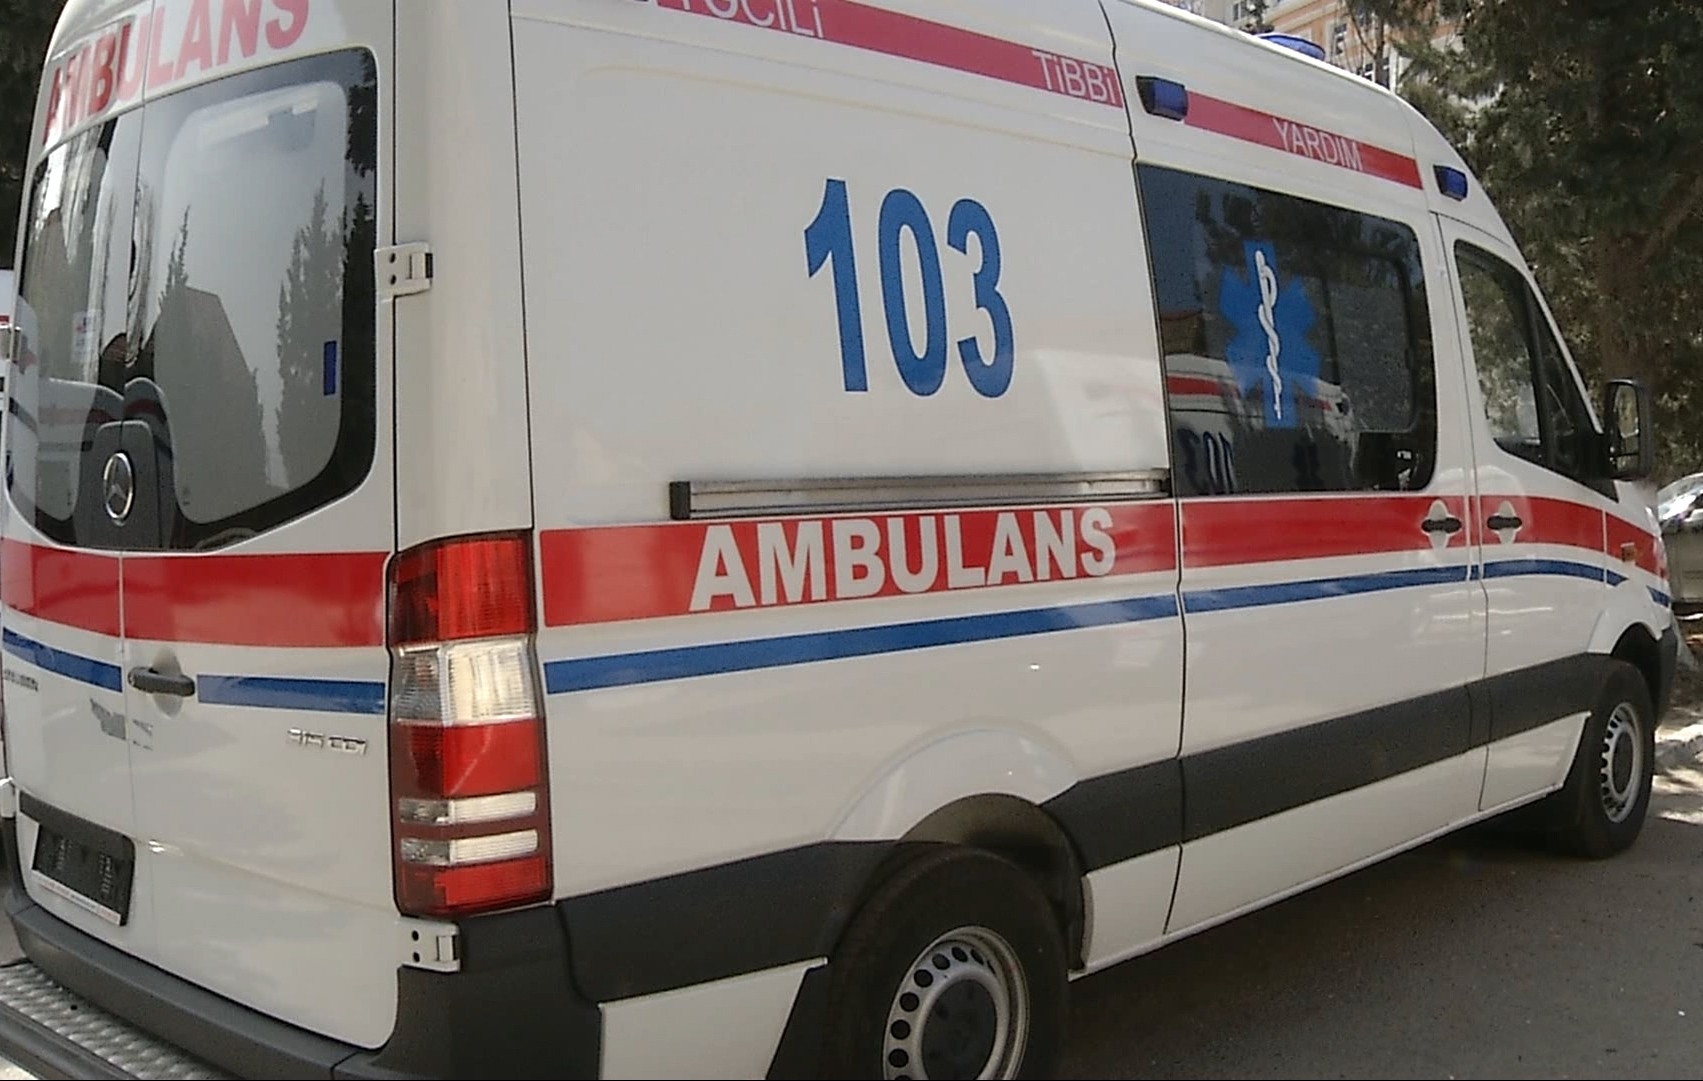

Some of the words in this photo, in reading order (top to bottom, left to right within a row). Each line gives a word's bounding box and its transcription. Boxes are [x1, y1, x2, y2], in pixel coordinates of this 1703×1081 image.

[42, 0, 309, 146] AMBULANS
[1273, 117, 1363, 171] YARDIM
[804, 178, 1014, 398] 103
[689, 508, 1116, 612] AMBULANS
